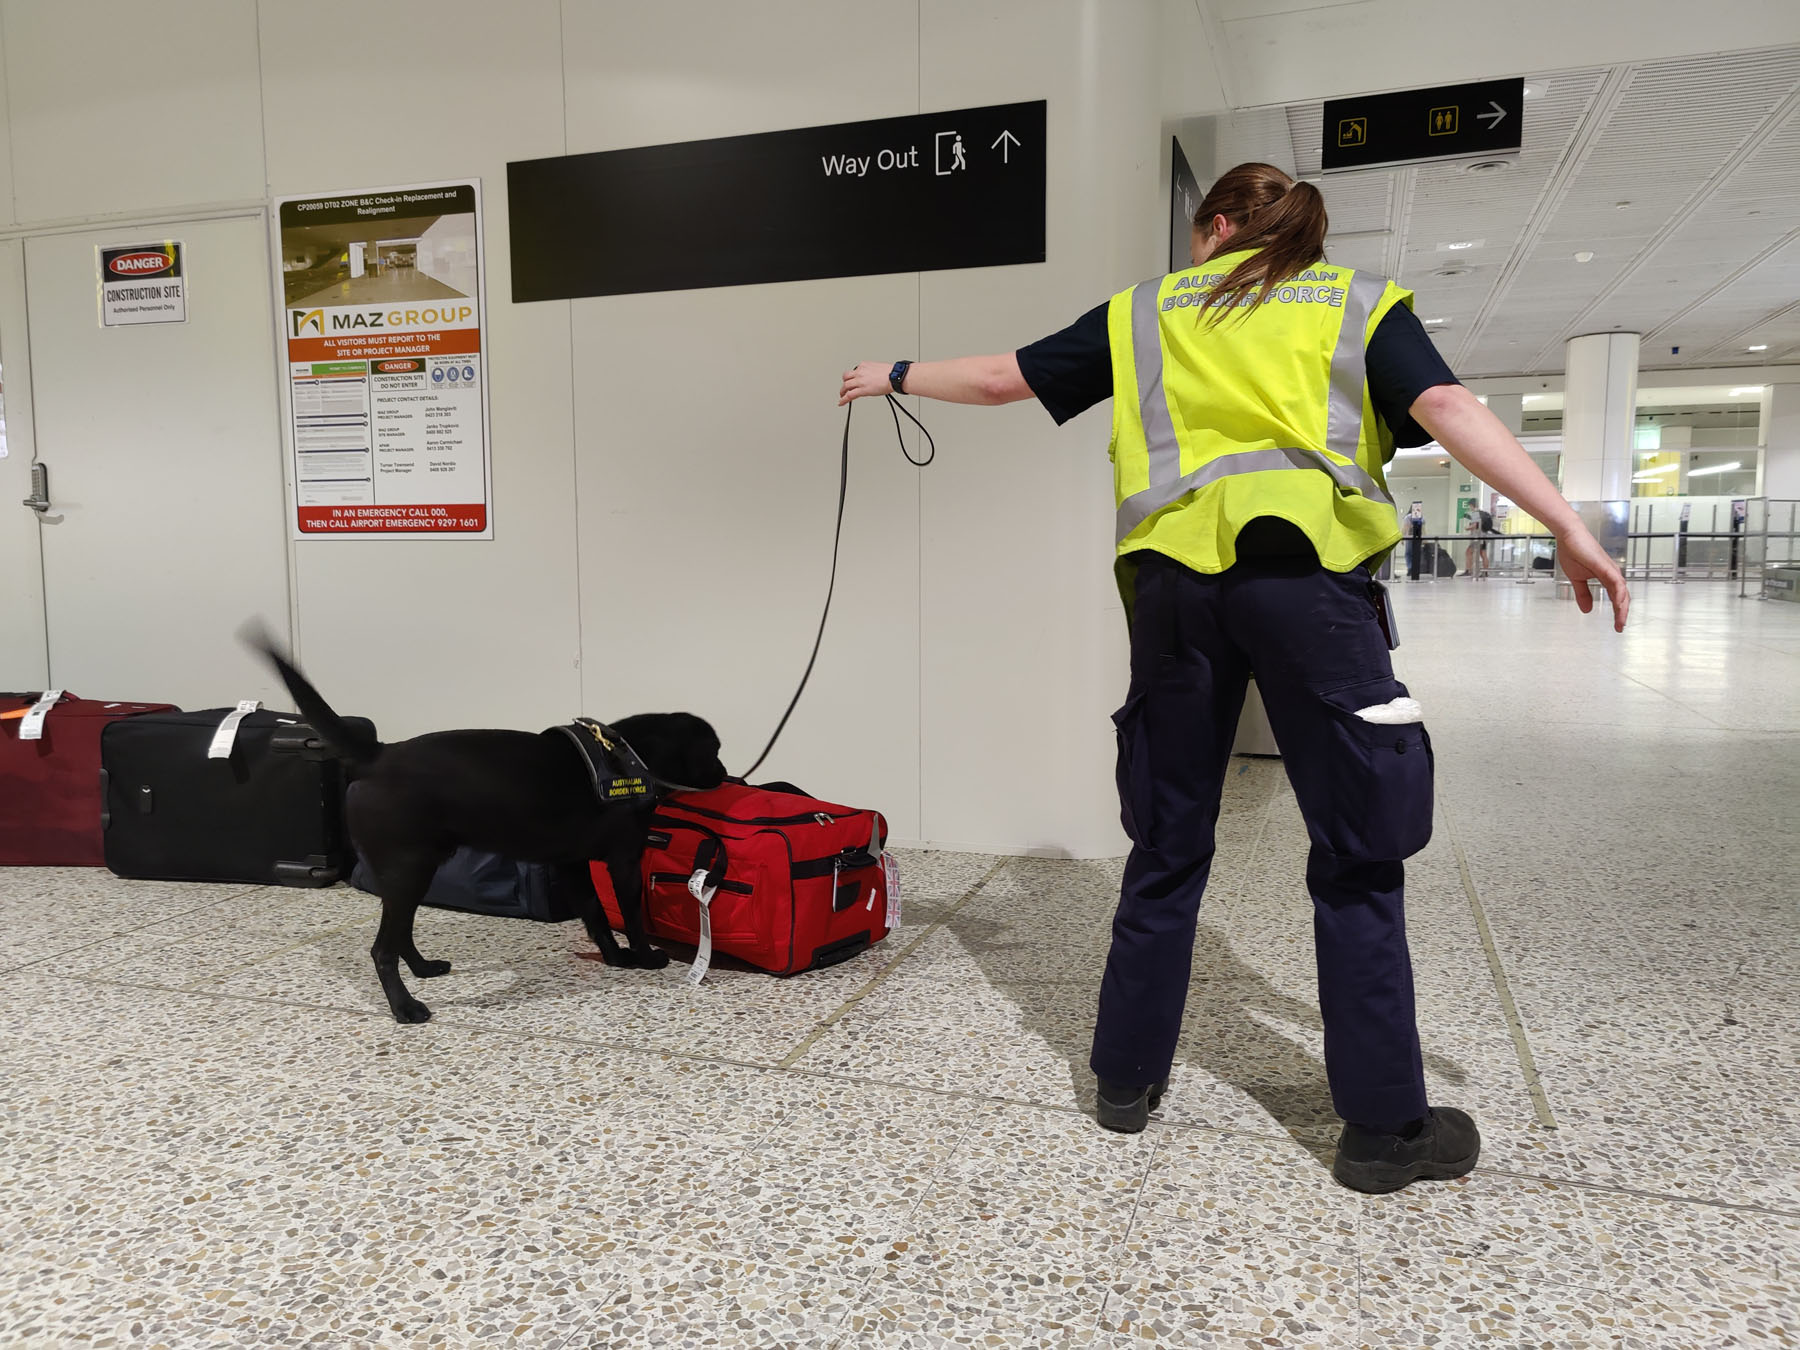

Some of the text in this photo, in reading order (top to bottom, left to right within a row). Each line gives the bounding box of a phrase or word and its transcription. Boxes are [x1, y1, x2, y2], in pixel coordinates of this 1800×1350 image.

[822, 146, 919, 177] Way Out
[360, 198, 374, 206] B&C
[375, 196, 402, 204] Check-in
[403, 192, 444, 202] Replacement
[357, 206, 395, 215] Realignment
[117, 257, 163, 270] DANGER
[107, 286, 180, 302] CONSTRUCTION SITE
[1264, 286, 1344, 307] FORCE
[324, 339, 336, 347] ALL
[338, 338, 367, 346] VISITORS
[368, 336, 387, 344] MUST
[388, 335, 414, 343] REPORT
[416, 334, 425, 342] TO
[364, 347, 393, 355] PROJECT
[395, 345, 430, 353] MANAGER
[333, 508, 448, 517] IN AN EMERGENCY CALL 000,
[306, 518, 478, 528] THEN CALL AIRPORT EMERGENCY 9297 1601
[612, 778, 642, 787] AUSTRALIAN
[609, 788, 629, 796] BORDER
